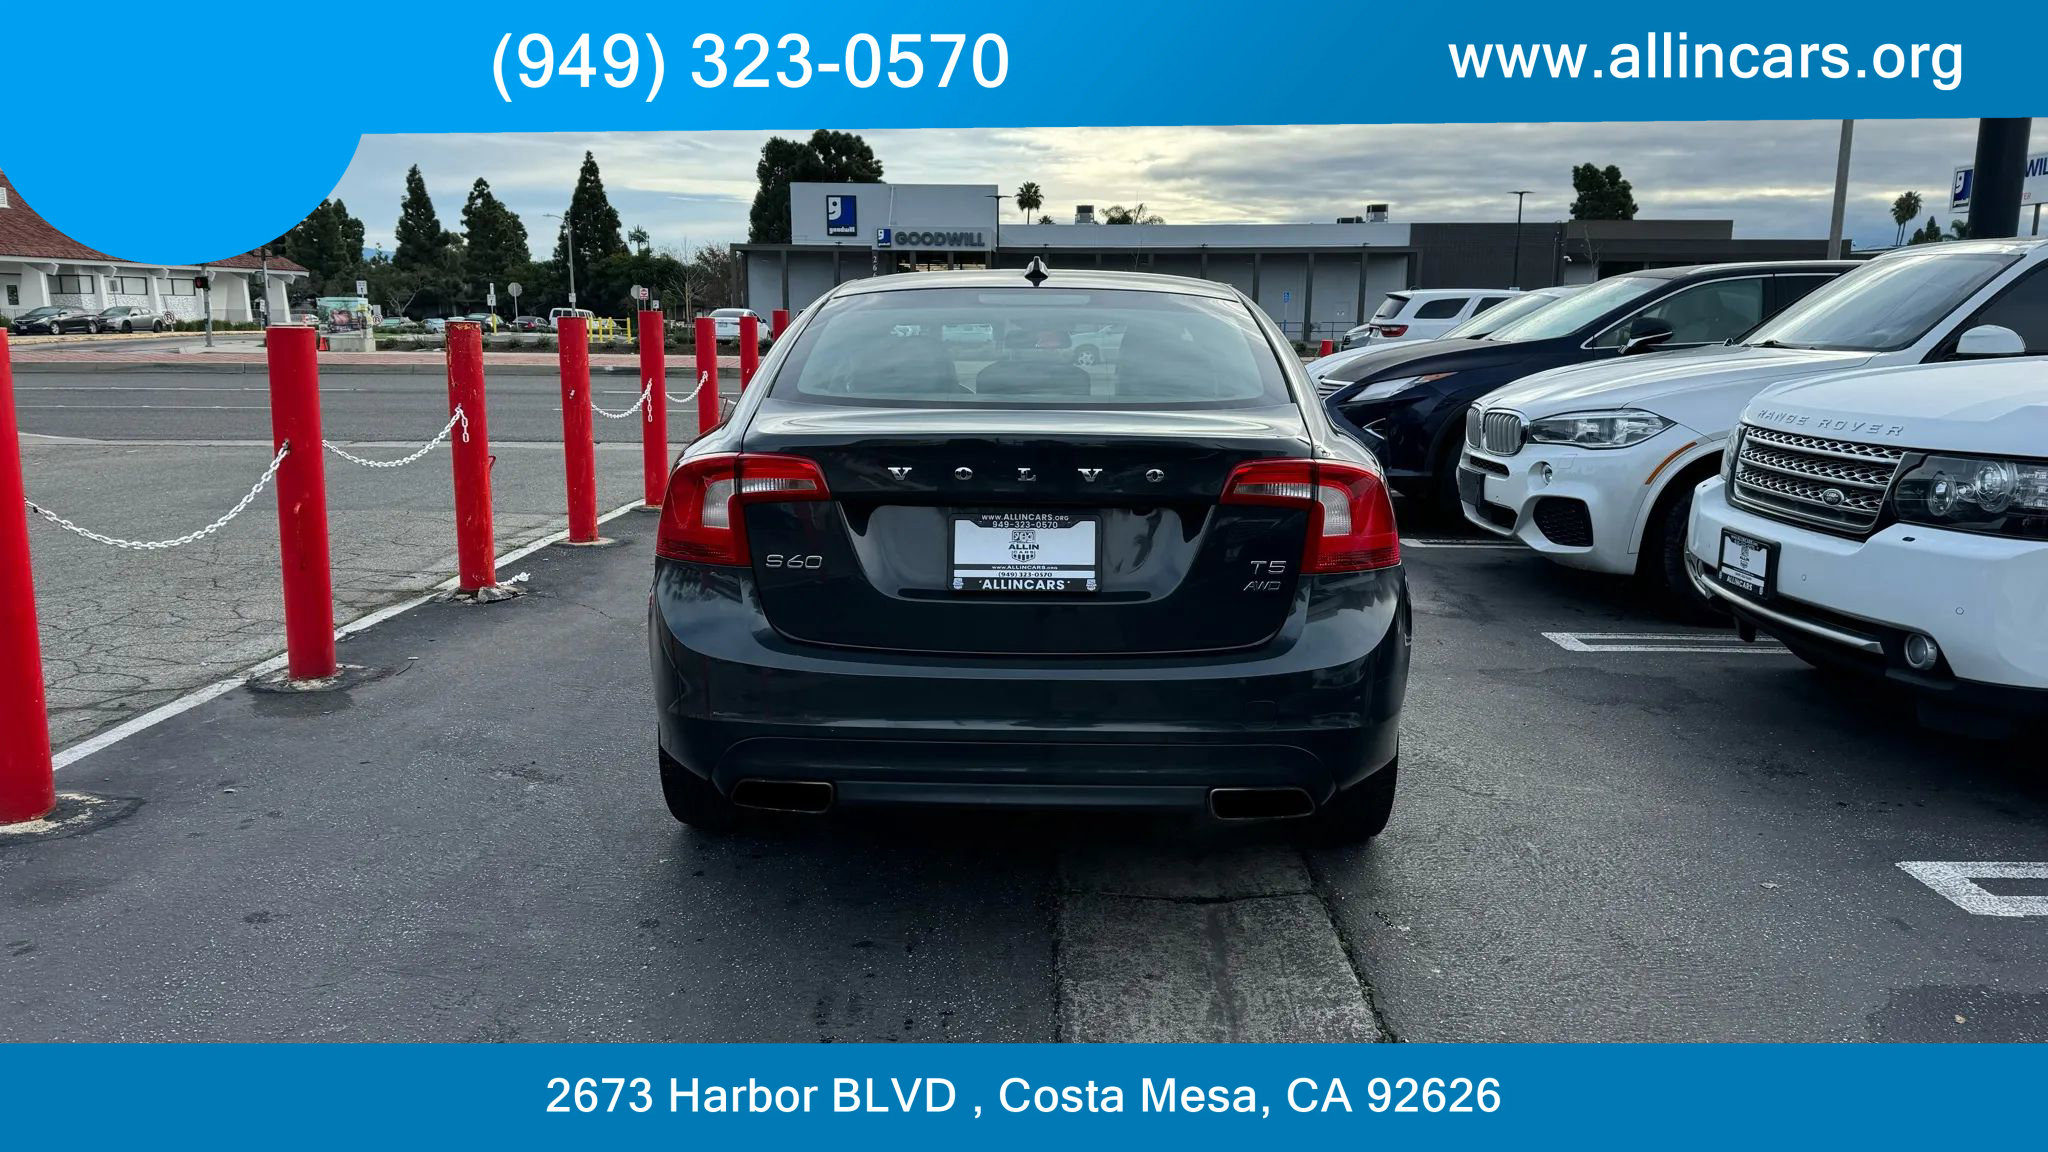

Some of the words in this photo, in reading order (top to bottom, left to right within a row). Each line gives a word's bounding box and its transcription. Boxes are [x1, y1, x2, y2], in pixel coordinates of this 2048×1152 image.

[828, 226, 856, 235] goodwill
[894, 231, 986, 247] GOODWILL
[1757, 409, 1811, 426] RANGE
[1817, 418, 1905, 437] ROVER
[887, 465, 1166, 484] VOLVO
[992, 521, 1059, 529] 949-323-0570
[765, 553, 824, 570] S60
[1250, 559, 1286, 575] T5
[981, 578, 1066, 591] ALLINCARS
[1243, 580, 1282, 593] AWD
